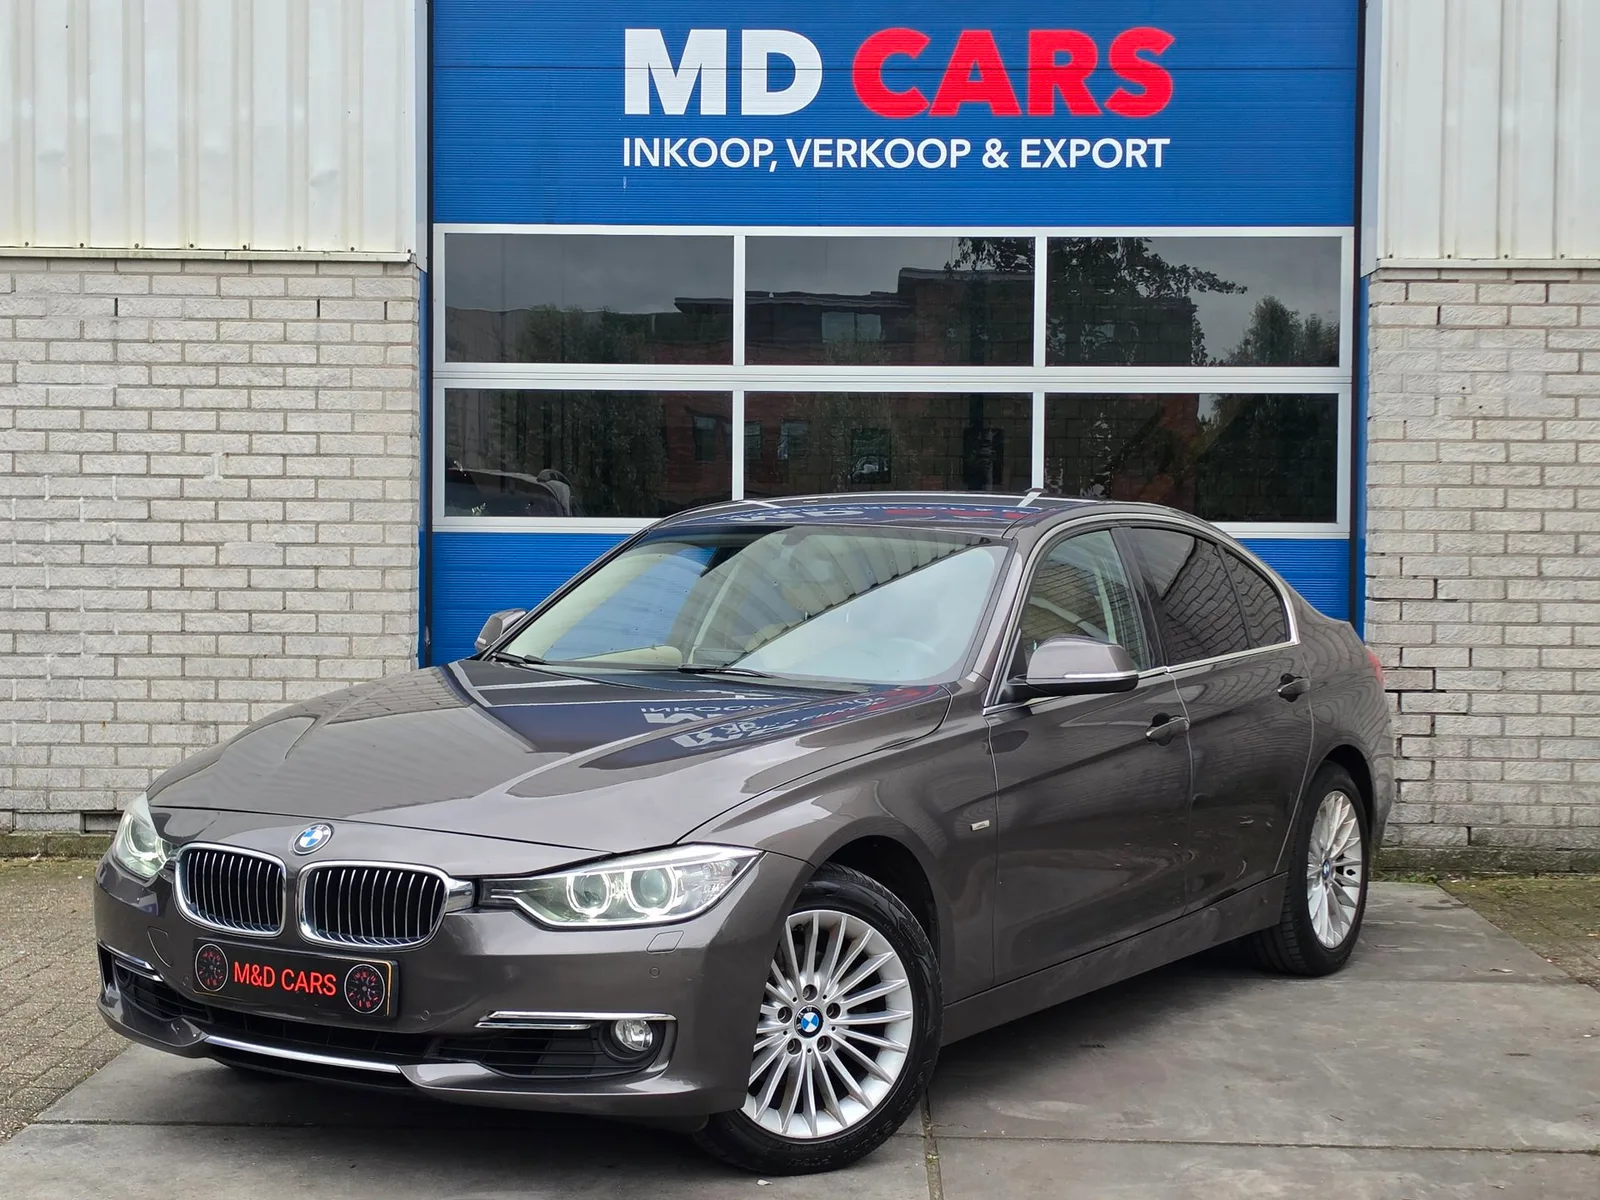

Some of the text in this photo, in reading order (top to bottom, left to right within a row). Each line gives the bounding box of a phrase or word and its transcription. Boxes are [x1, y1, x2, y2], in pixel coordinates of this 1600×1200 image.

[624, 26, 1176, 118] MD CARS
[622, 137, 1171, 172] INKOOP, VERKOOP & EXPORT
[234, 961, 276, 988] M&D
[281, 968, 337, 996] CARS
